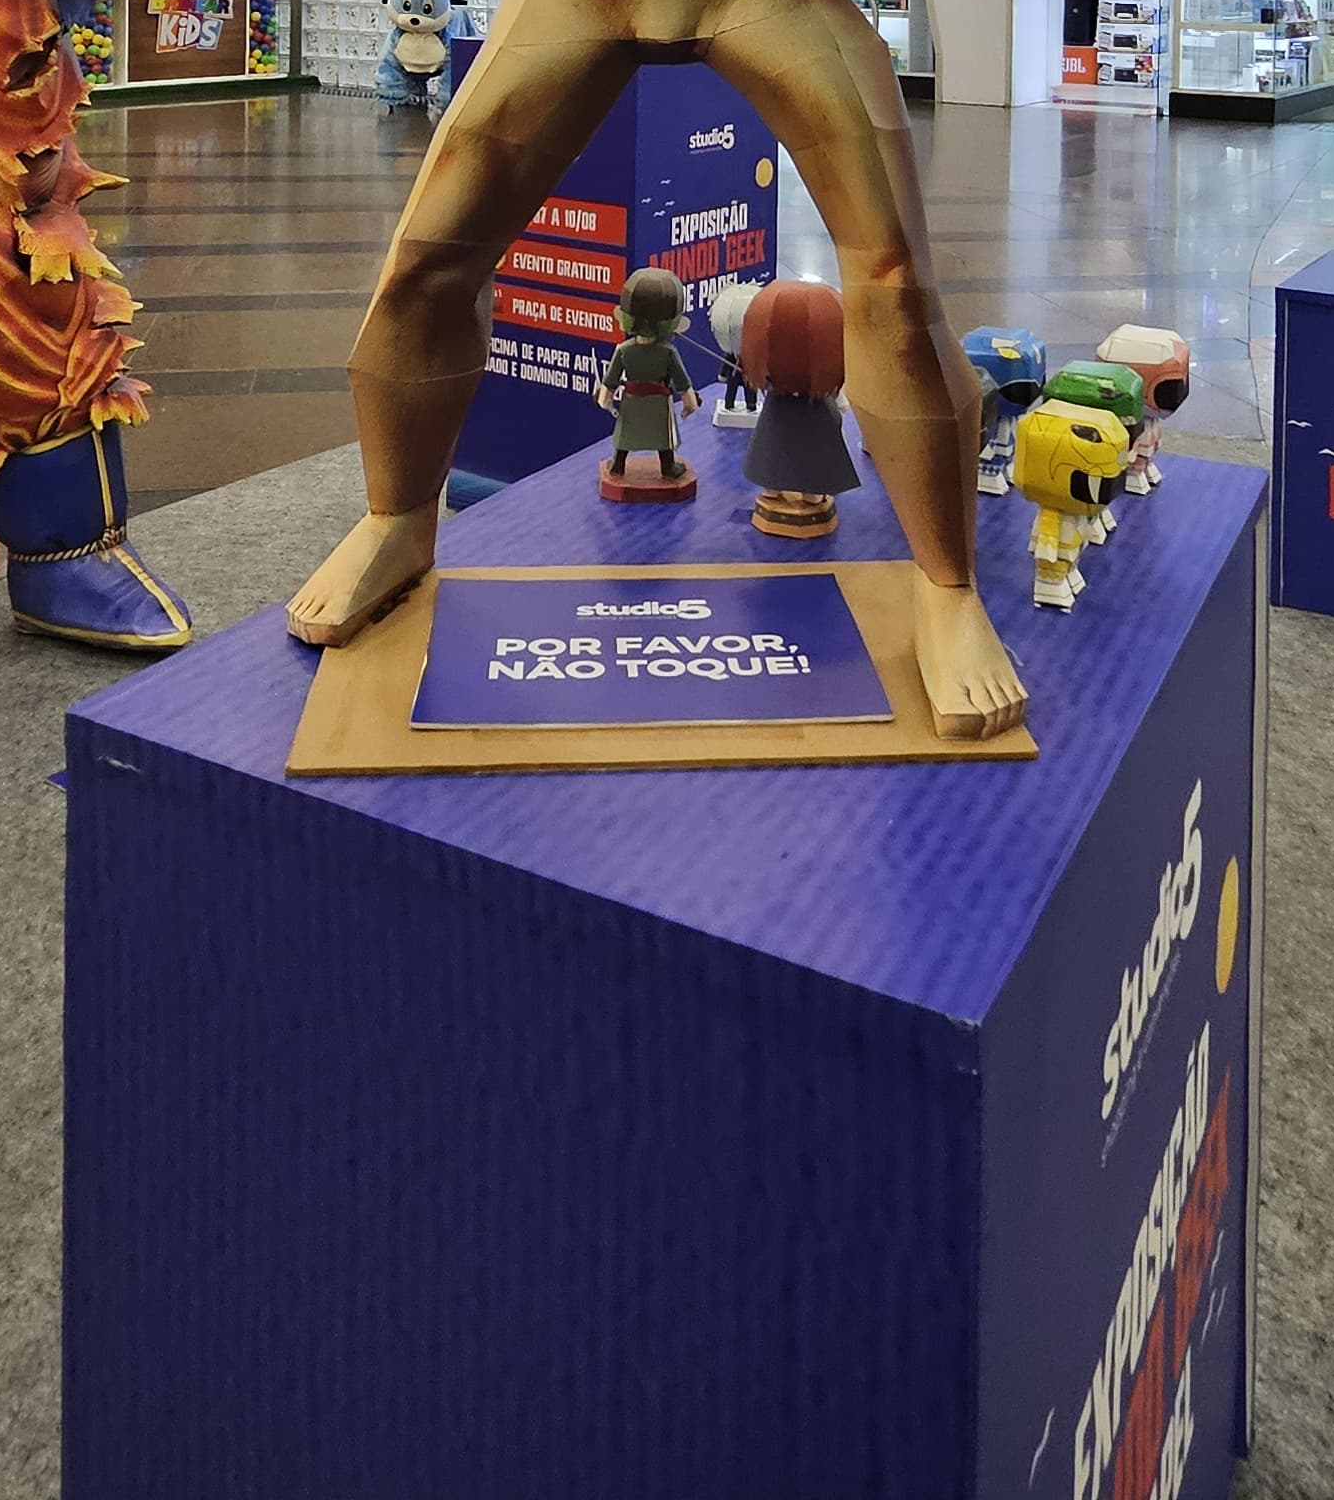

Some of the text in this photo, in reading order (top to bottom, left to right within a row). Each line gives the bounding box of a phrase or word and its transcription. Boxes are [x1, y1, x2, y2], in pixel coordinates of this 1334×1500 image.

[689, 124, 735, 150] studio5
[551, 207, 560, 226] A
[565, 209, 596, 233] 10/08
[671, 201, 748, 246] EXPOSIÇÃO
[726, 229, 766, 270] GEEK
[513, 252, 611, 284] EVENTO GRATUITO
[512, 298, 614, 333] PRAÇA DE EVENTOS
[521, 343, 534, 361] DE
[537, 346, 570, 369] PAPER
[511, 360, 518, 378] E
[520, 363, 569, 389] DOMINGO
[572, 374, 589, 394] 16H
[576, 599, 712, 619] studio5
[496, 634, 799, 656] POR FAVOR,
[488, 655, 812, 680] NÃO TOQUE!
[1101, 776, 1203, 1121] studio5
